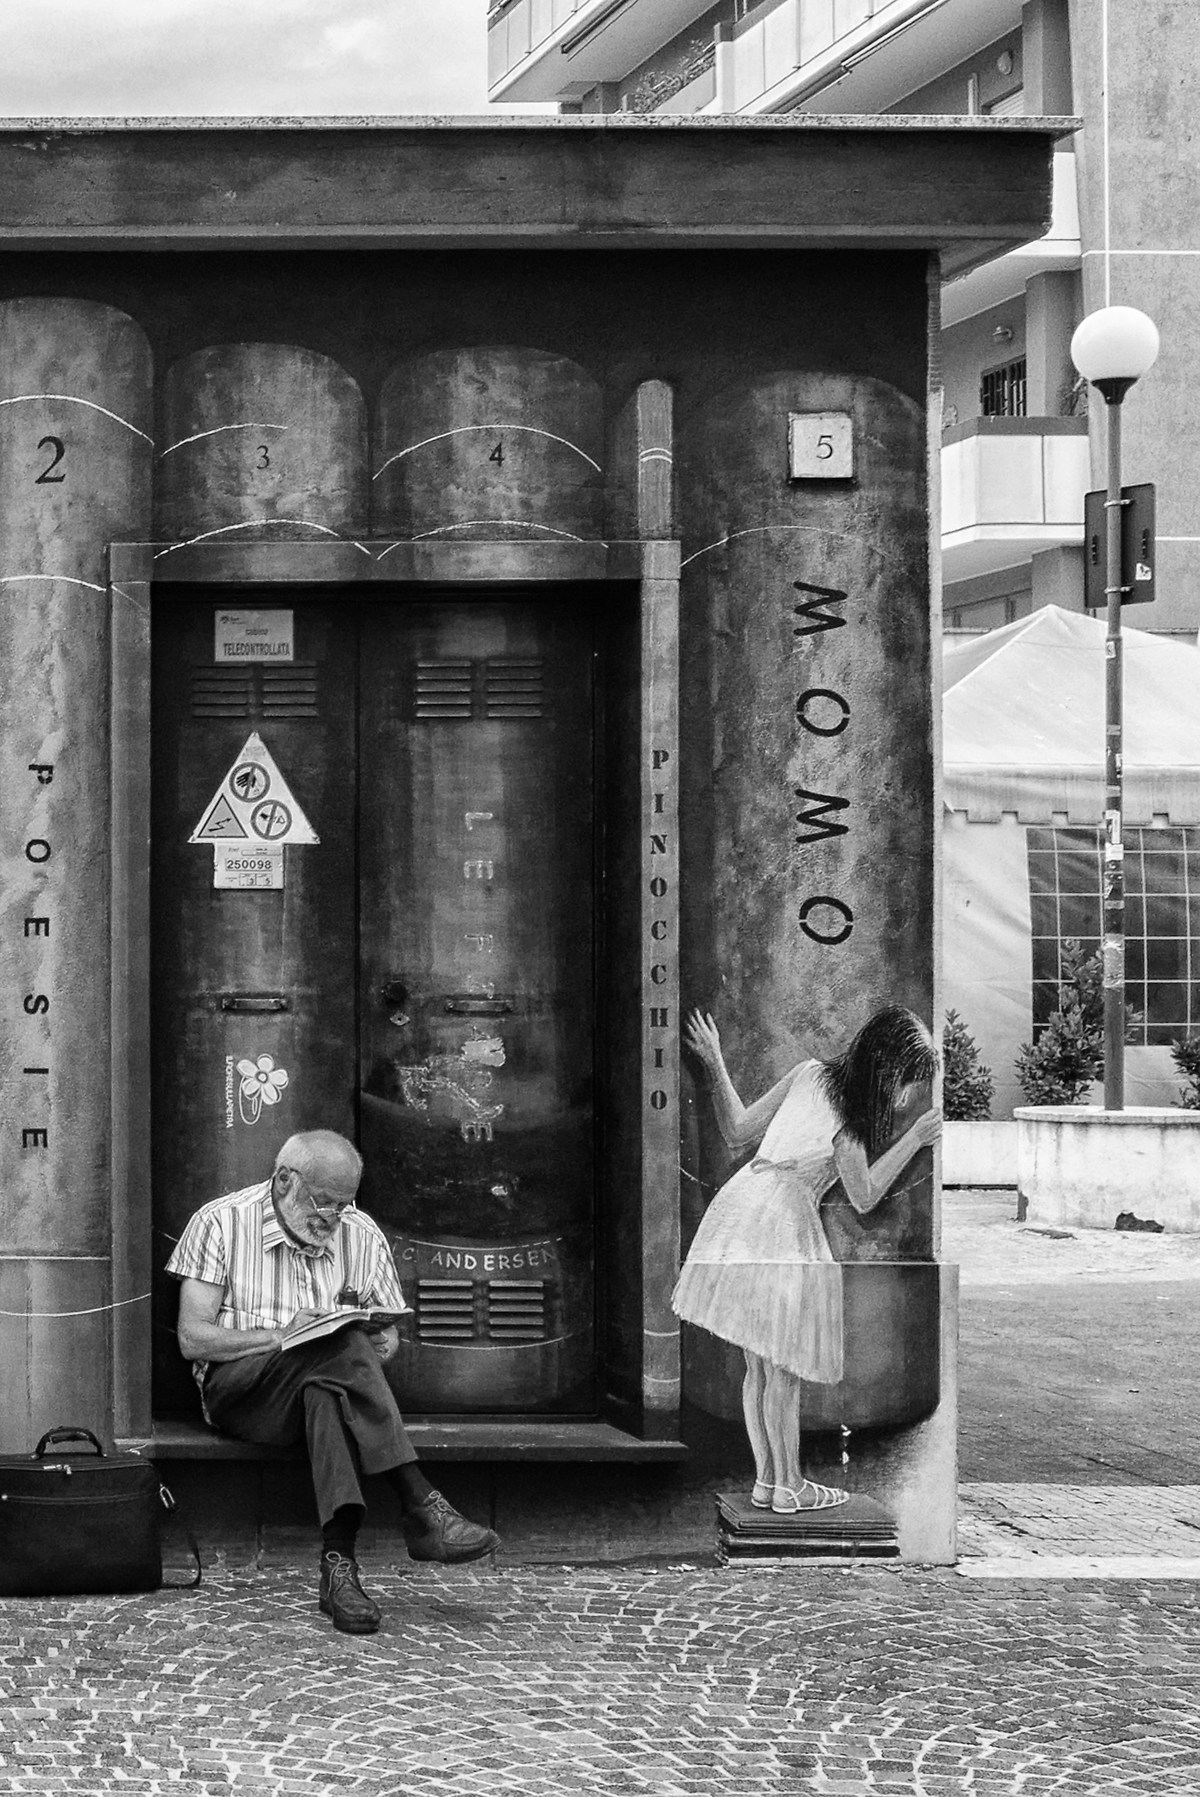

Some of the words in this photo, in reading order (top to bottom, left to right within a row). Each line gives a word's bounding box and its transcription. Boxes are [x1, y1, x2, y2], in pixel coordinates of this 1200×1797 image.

[34, 435, 66, 485] 2
[255, 445, 270, 470] 3
[488, 442, 505, 468] 4
[816, 435, 833, 460] 5
[226, 859, 272, 870] 250098
[649, 749, 670, 1110] PINOCCHIO
[21, 763, 54, 1149] POESIE
[431, 1247, 557, 1271] ANDERSEN
